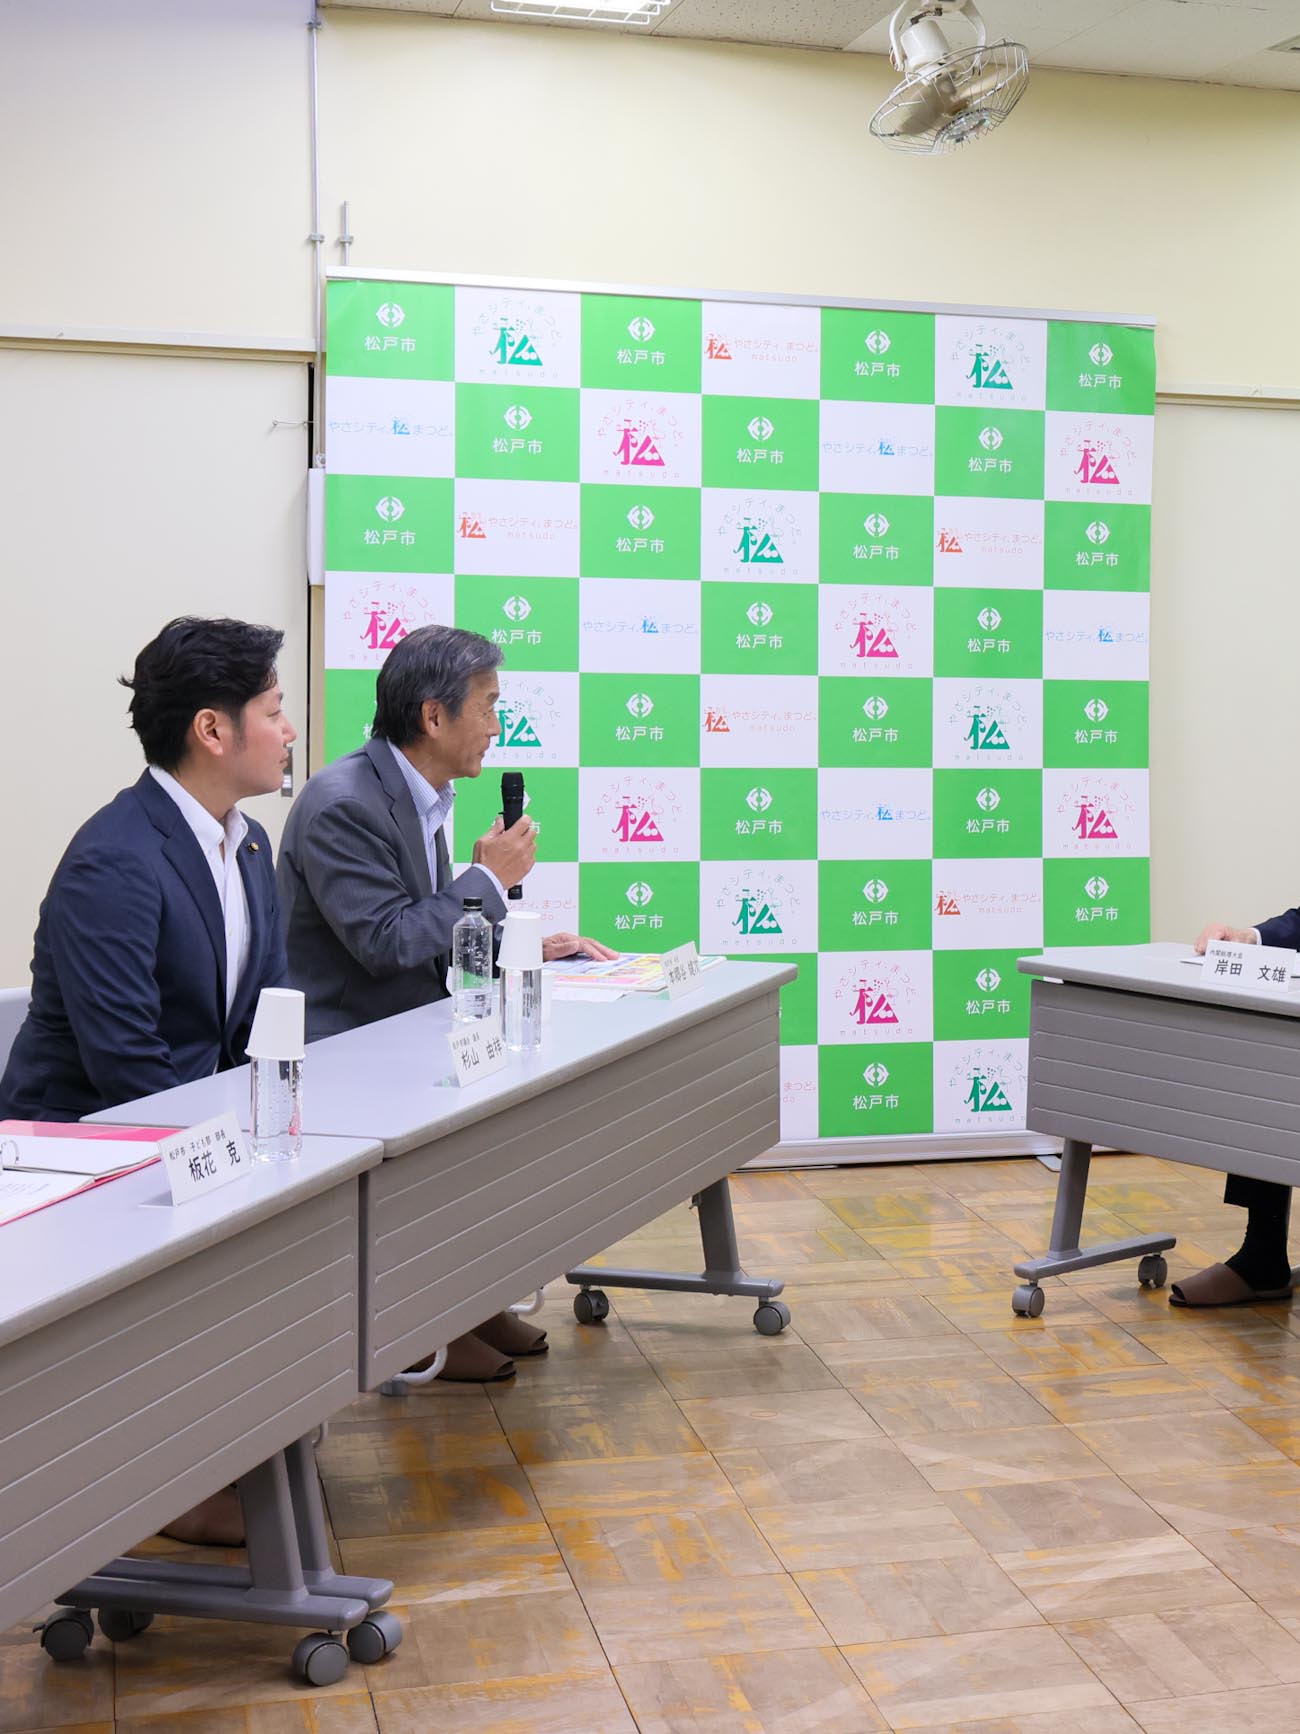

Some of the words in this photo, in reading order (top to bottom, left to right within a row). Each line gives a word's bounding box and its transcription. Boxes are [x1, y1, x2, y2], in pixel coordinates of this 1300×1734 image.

[364, 334, 416, 353] 松戸市
[616, 348, 665, 366] 松戸市
[854, 361, 900, 378] 松戸市
[1078, 372, 1122, 389] 松戸市
[492, 437, 542, 454] 松戸市
[736, 448, 784, 464] 松戸市
[968, 457, 1012, 473] 松戸市
[363, 529, 415, 546] 松戸市
[615, 537, 664, 553] 松戸市
[853, 544, 899, 560] 松戸市
[1075, 551, 1119, 567] 松戸市
[491, 628, 542, 645] 松戸市
[735, 633, 783, 649] 松戸市
[966, 638, 1011, 653] 松戸市
[615, 725, 664, 741] 松戸市
[852, 727, 898, 742] 松戸市
[1074, 729, 1117, 744] 松戸市
[735, 819, 782, 834] 松戸市
[965, 818, 1010, 833] 松戸市
[614, 914, 663, 930] 松戸市
[852, 910, 898, 926] 松戸市
[1074, 906, 1118, 922] 松戸市
[1214, 959, 1243, 976] 岸田
[1257, 965, 1287, 983] 文雄
[965, 998, 1010, 1014] 松戸市
[461, 1047, 480, 1071] 杉山
[852, 1093, 898, 1110] 松戸市
[169, 1147, 186, 1160] 松戸市
[189, 1150, 217, 1182] 板花
[226, 1140, 241, 1167] 克
